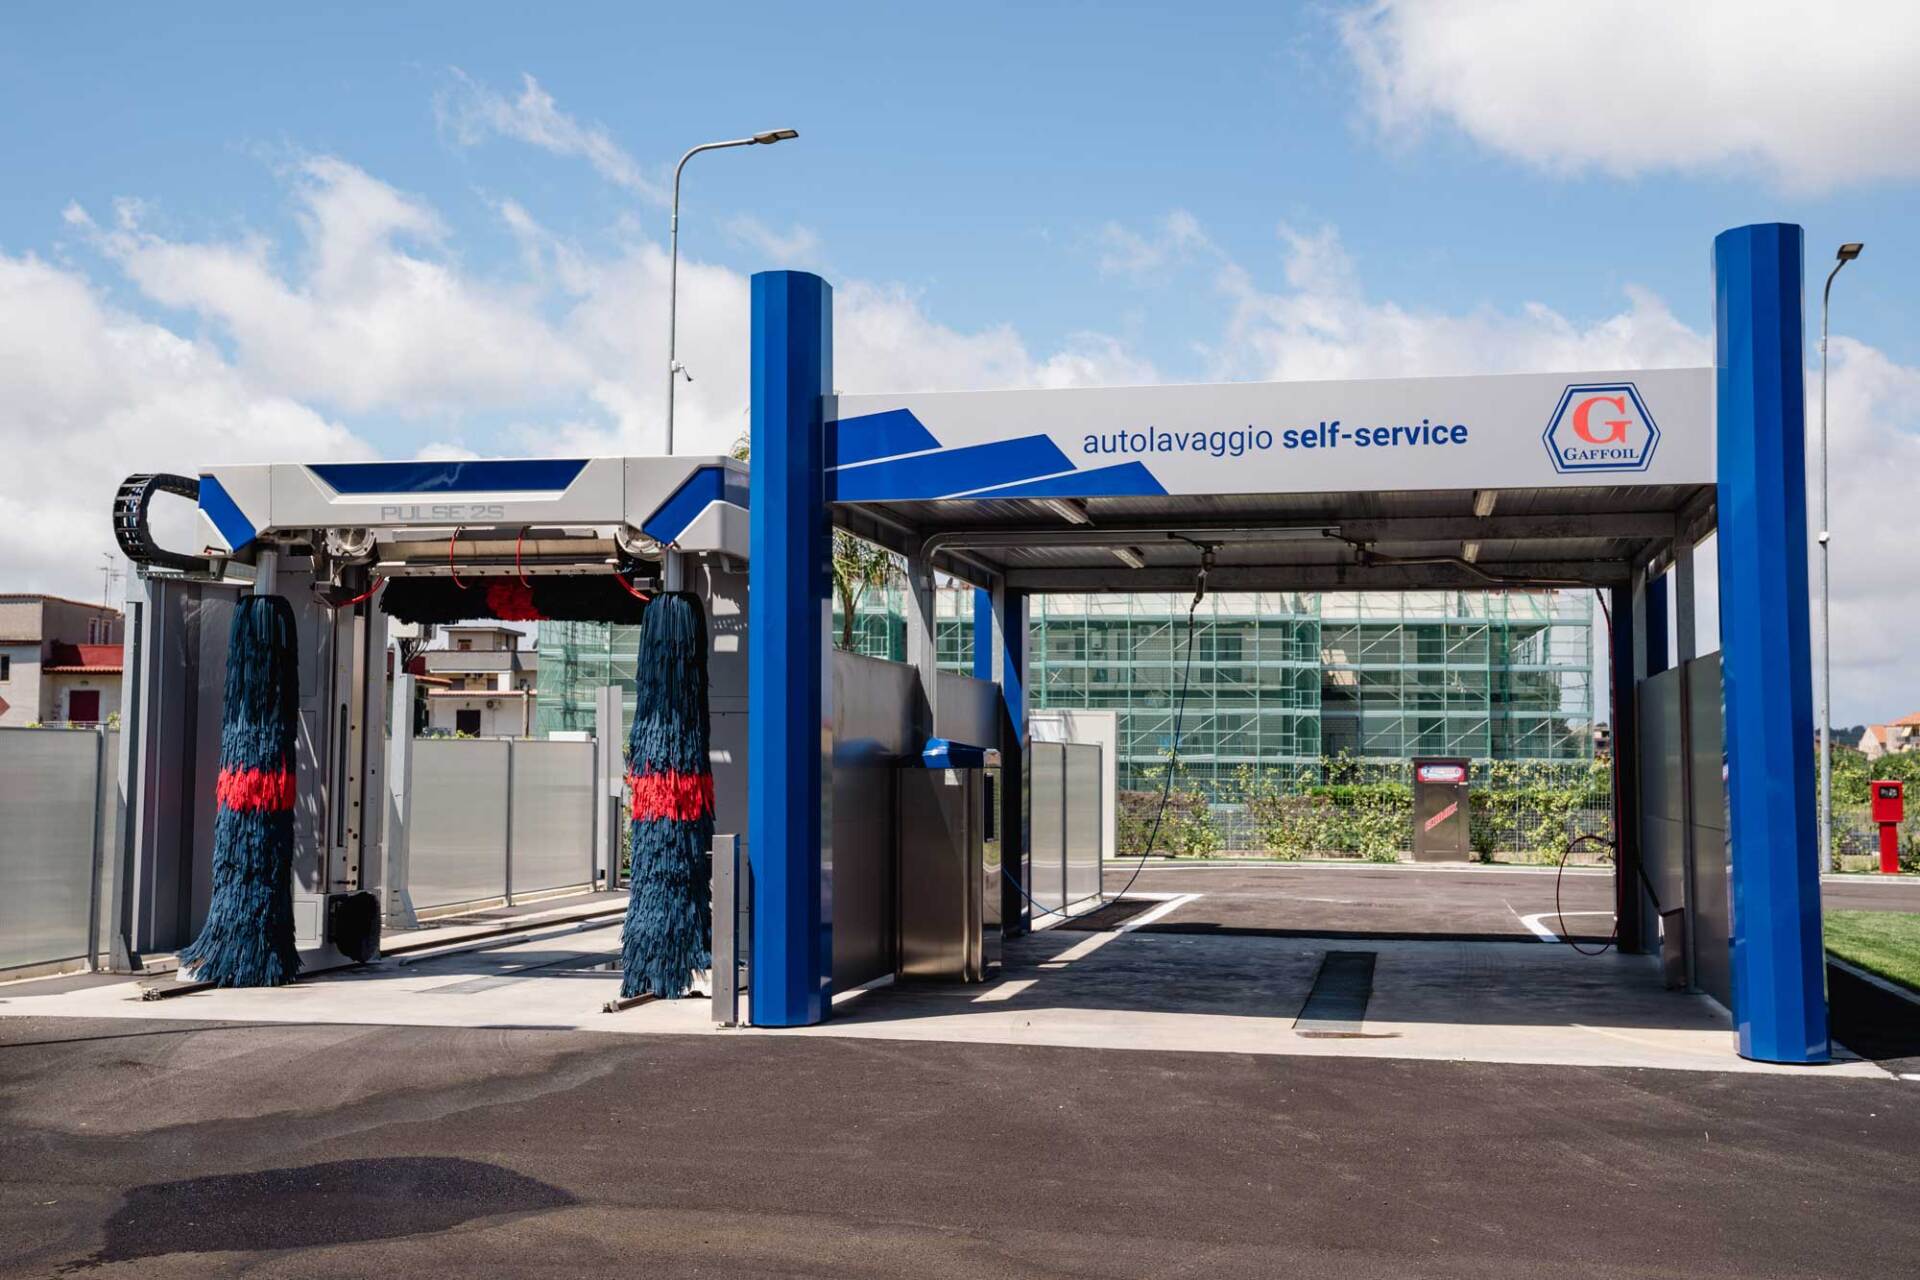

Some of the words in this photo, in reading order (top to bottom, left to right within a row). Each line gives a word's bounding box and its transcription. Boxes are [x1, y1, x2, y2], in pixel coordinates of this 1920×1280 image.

[1572, 396, 1632, 444] G
[1083, 425, 1273, 457] autolavaggio
[1282, 419, 1469, 448] self-service
[1563, 447, 1640, 461] GAFFOIL
[381, 504, 465, 521] PULSE
